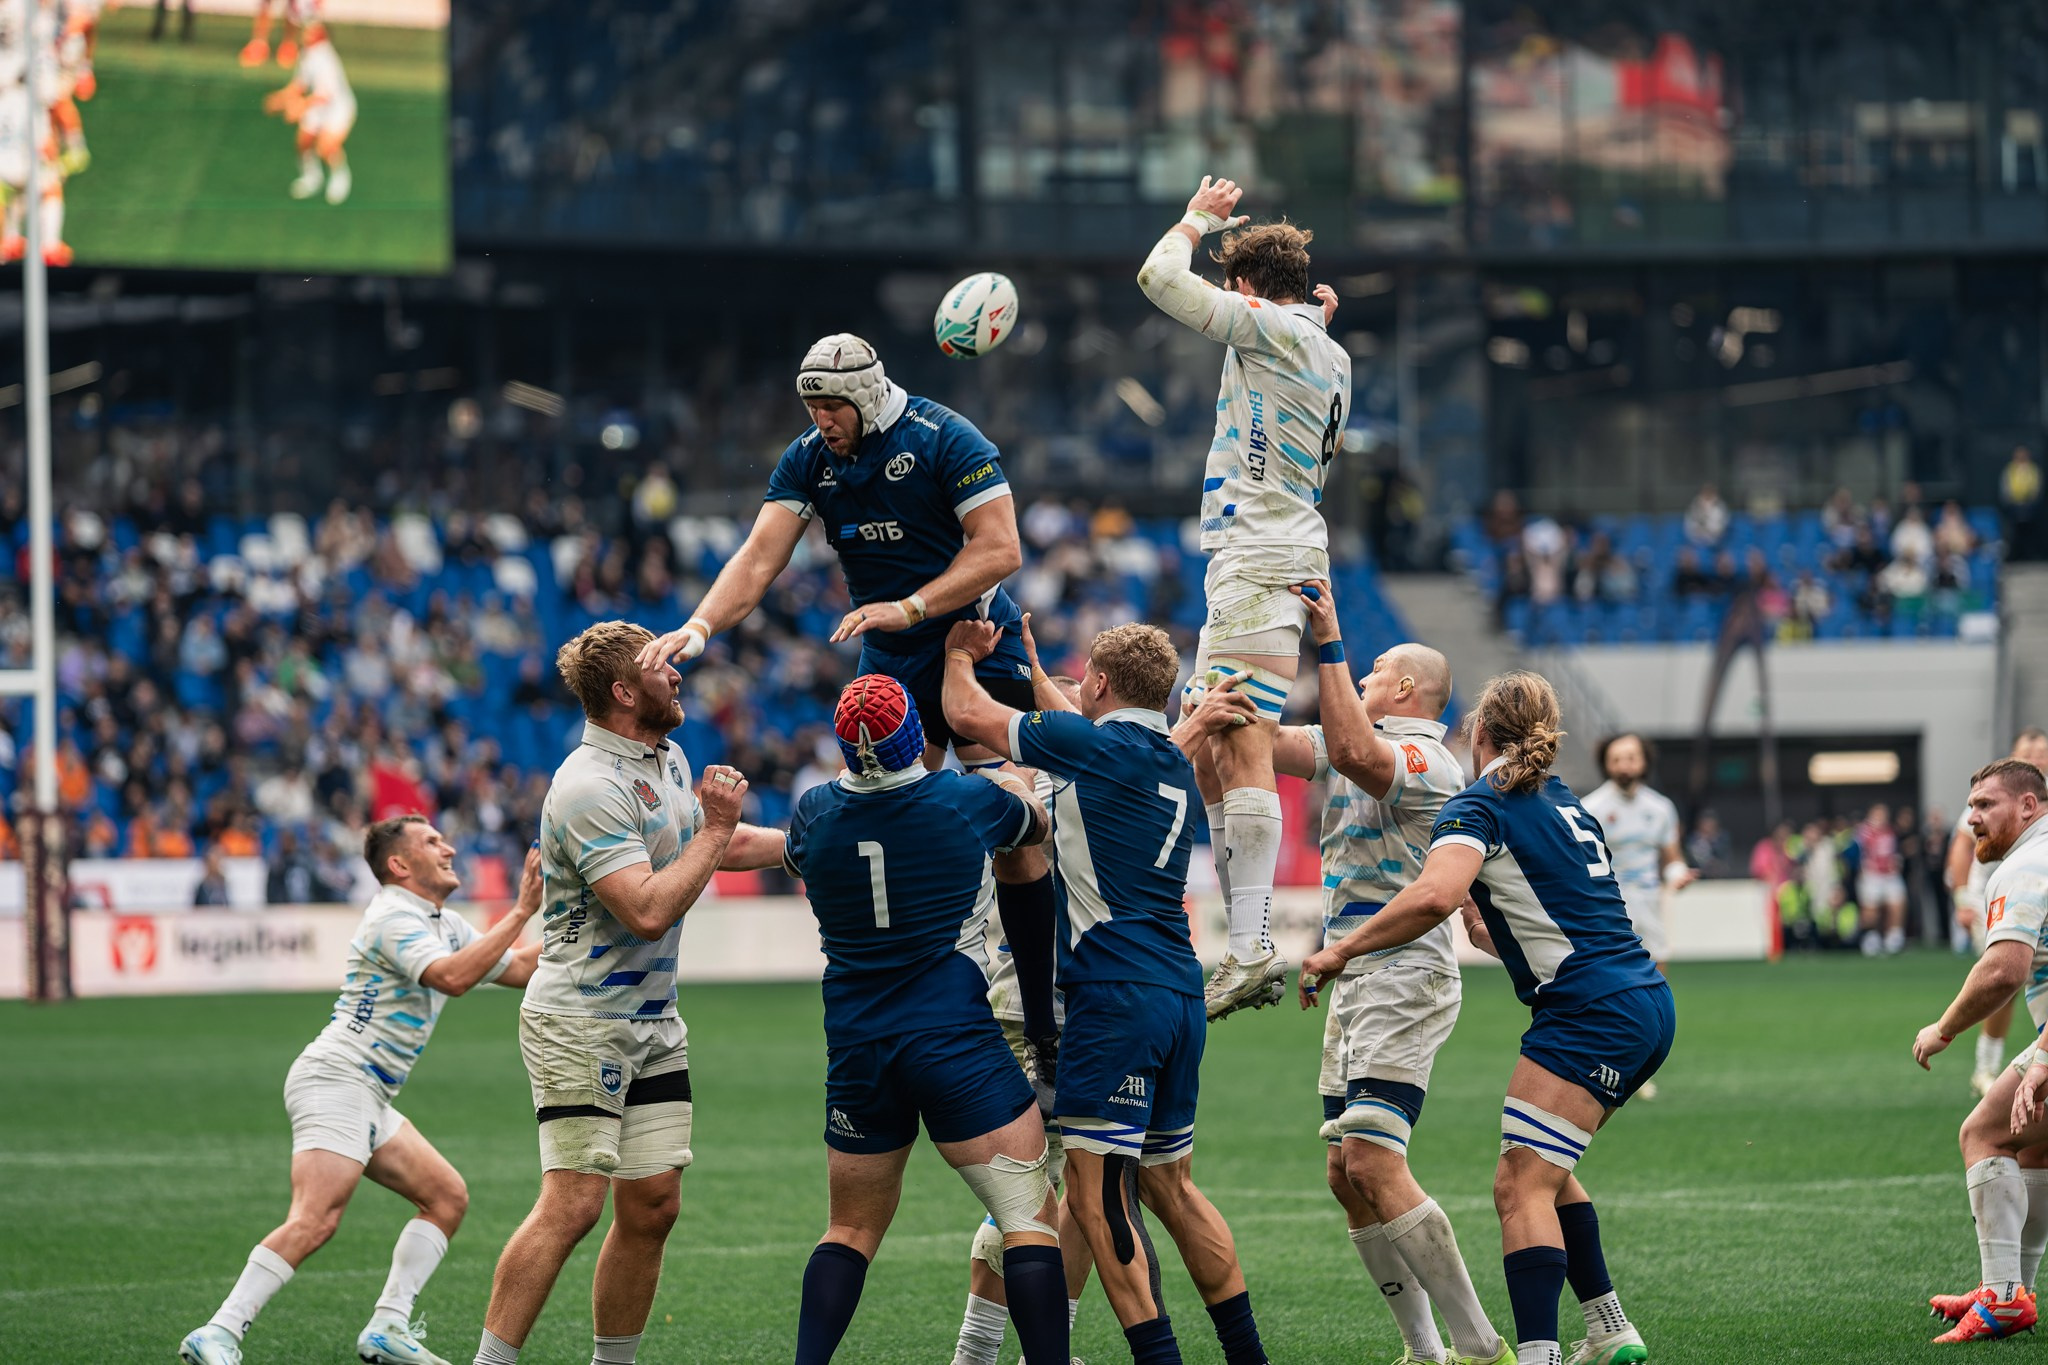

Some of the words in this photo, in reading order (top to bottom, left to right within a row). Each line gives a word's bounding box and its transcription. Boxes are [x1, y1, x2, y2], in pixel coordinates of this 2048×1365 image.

[1322, 392, 1342, 466] 8
[858, 521, 904, 541] ВТБ
[1154, 782, 1188, 869] 7
[1555, 805, 1611, 877] 5
[857, 840, 890, 929] 1
[1108, 1095, 1149, 1108] ARBATHALL
